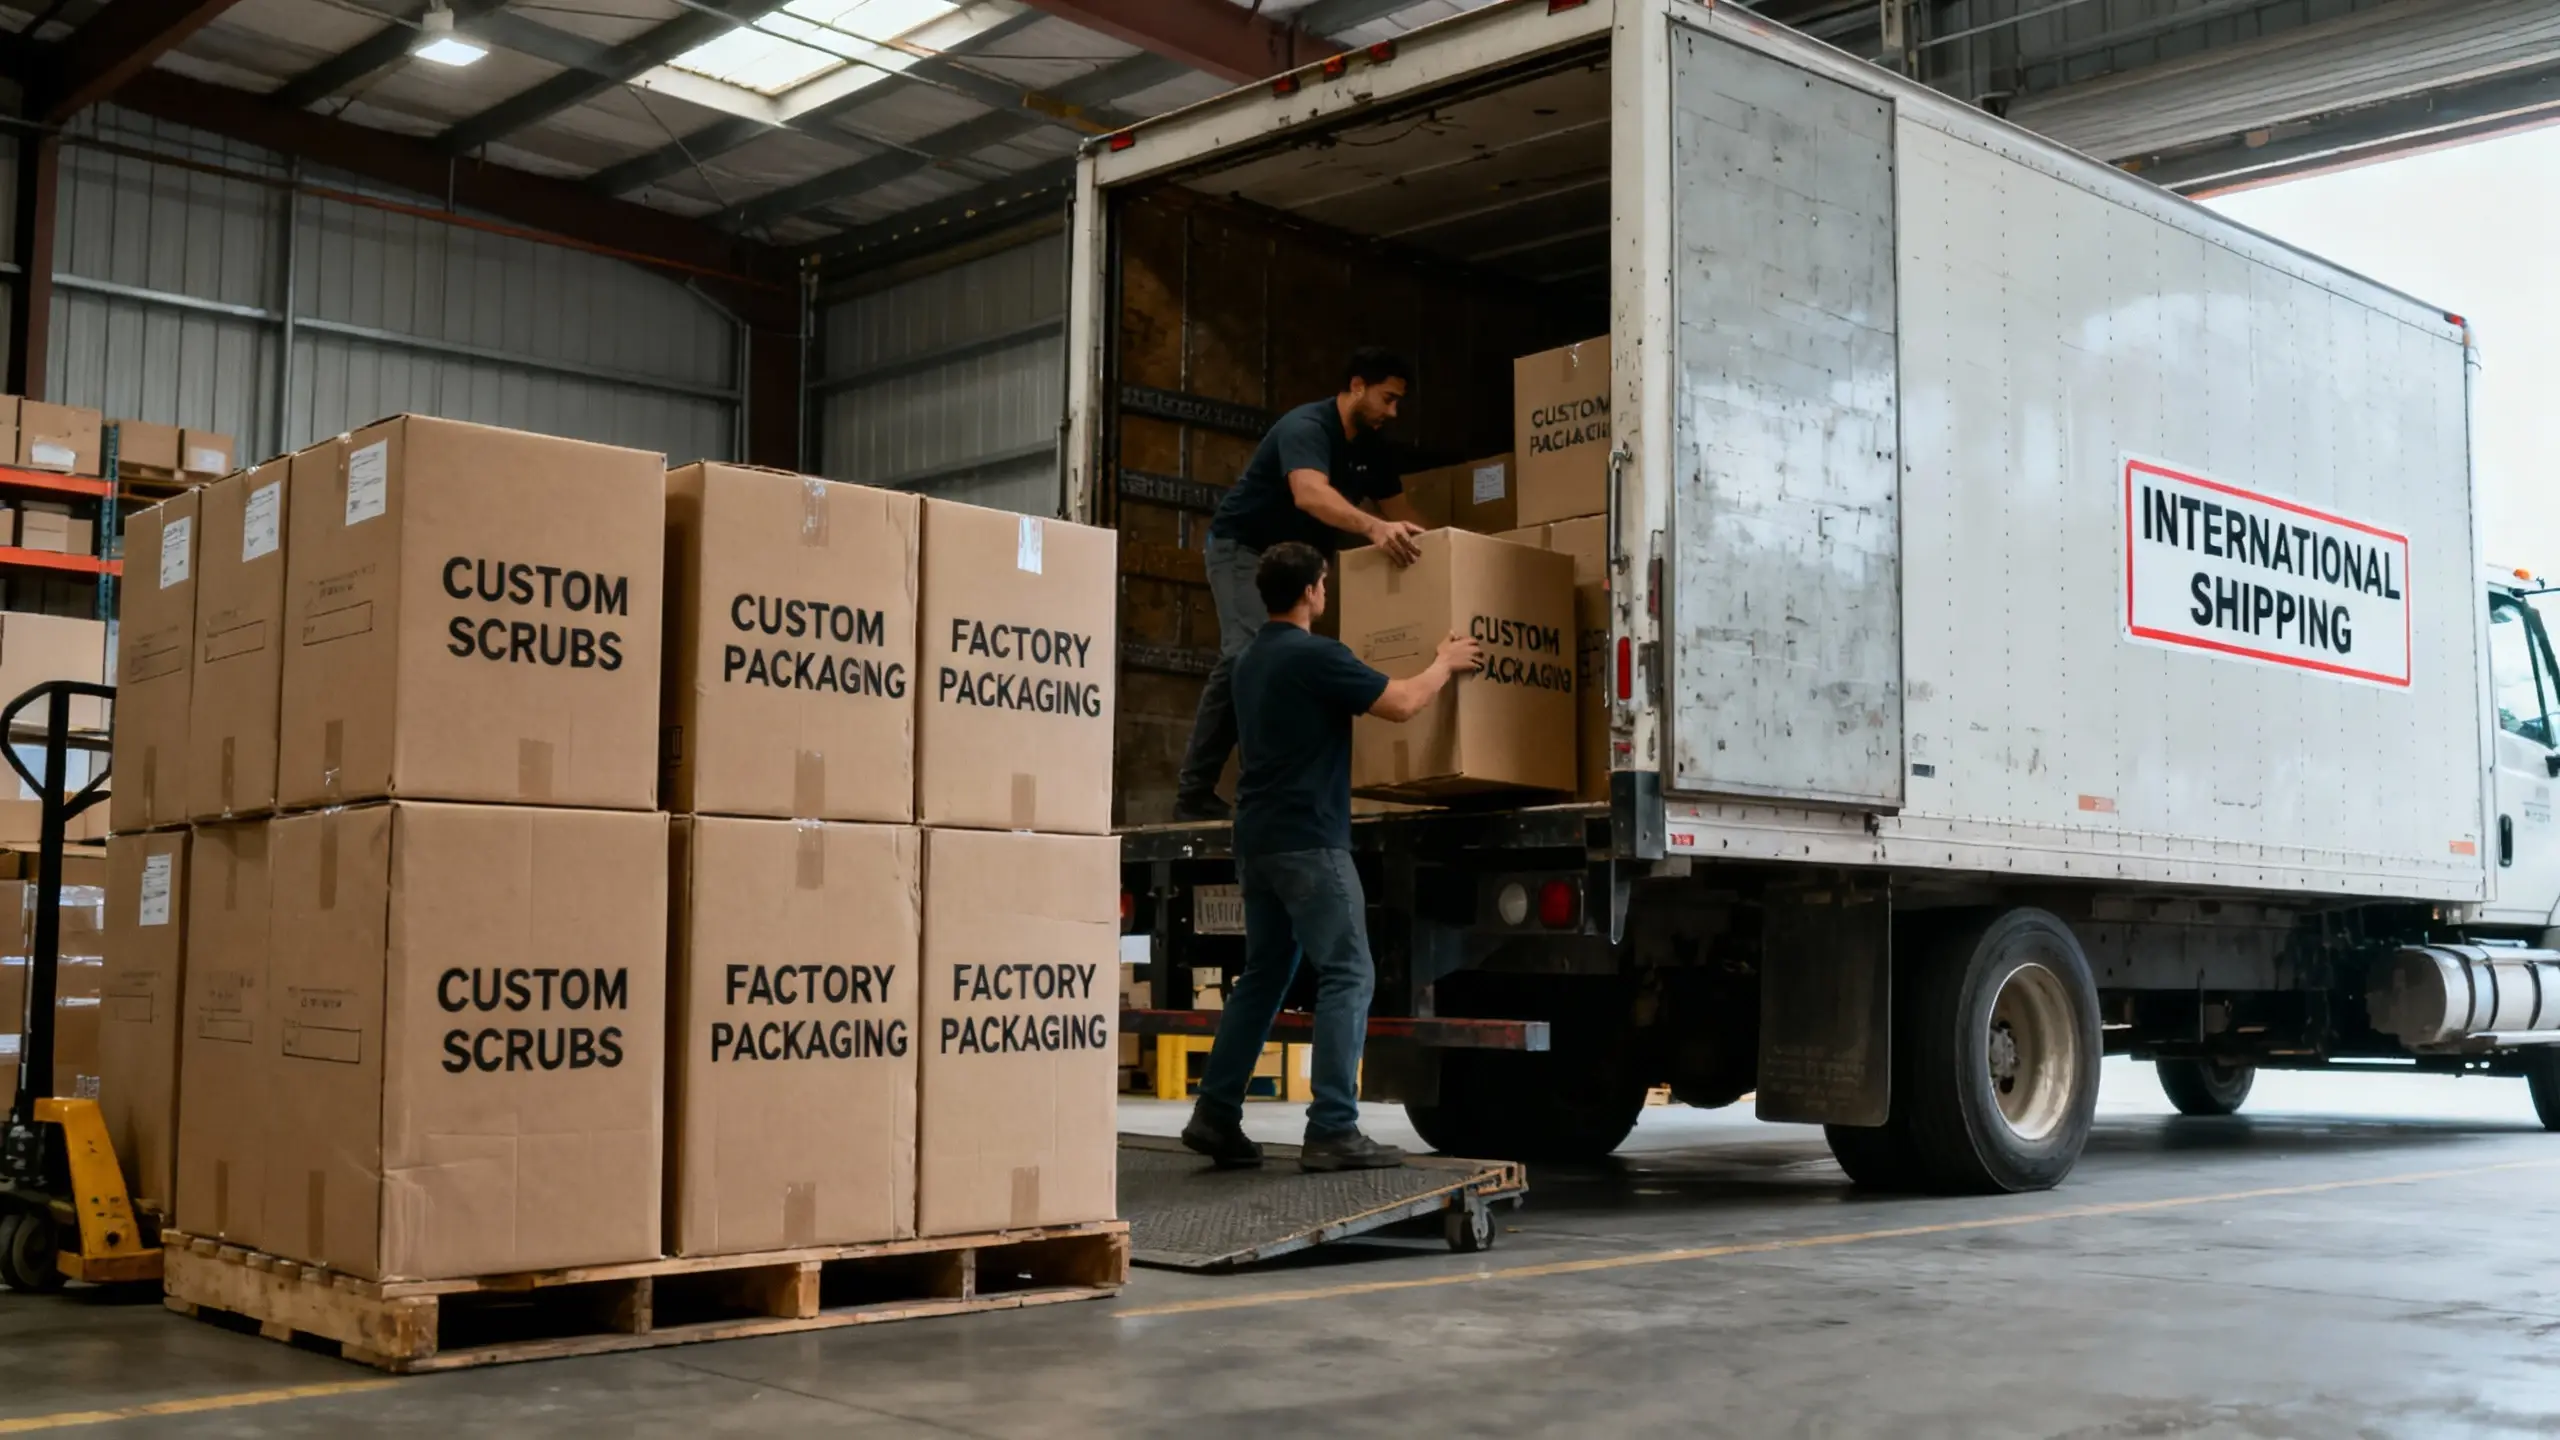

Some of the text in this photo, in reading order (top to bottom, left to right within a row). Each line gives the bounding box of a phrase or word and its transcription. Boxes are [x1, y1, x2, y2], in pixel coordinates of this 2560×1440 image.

[2143, 485, 2401, 601] INTERNATIONAL
[442, 556, 628, 617] CUSTOM
[730, 593, 884, 647] CUSTOM
[1471, 615, 1560, 656] CUSTOM
[2190, 571, 2352, 655] SHIPPING
[447, 615, 623, 672] SCRUBS
[951, 617, 1091, 669] FACTORY
[939, 666, 1101, 718] PACKAGING
[437, 967, 628, 1014] CUSTOM
[726, 963, 896, 1006] FACTORY
[953, 963, 1097, 1002] FACTORY
[441, 1026, 624, 1074] SCRUBS
[711, 1019, 908, 1063] PACKAGING
[940, 1014, 1107, 1056] PACKAGING
